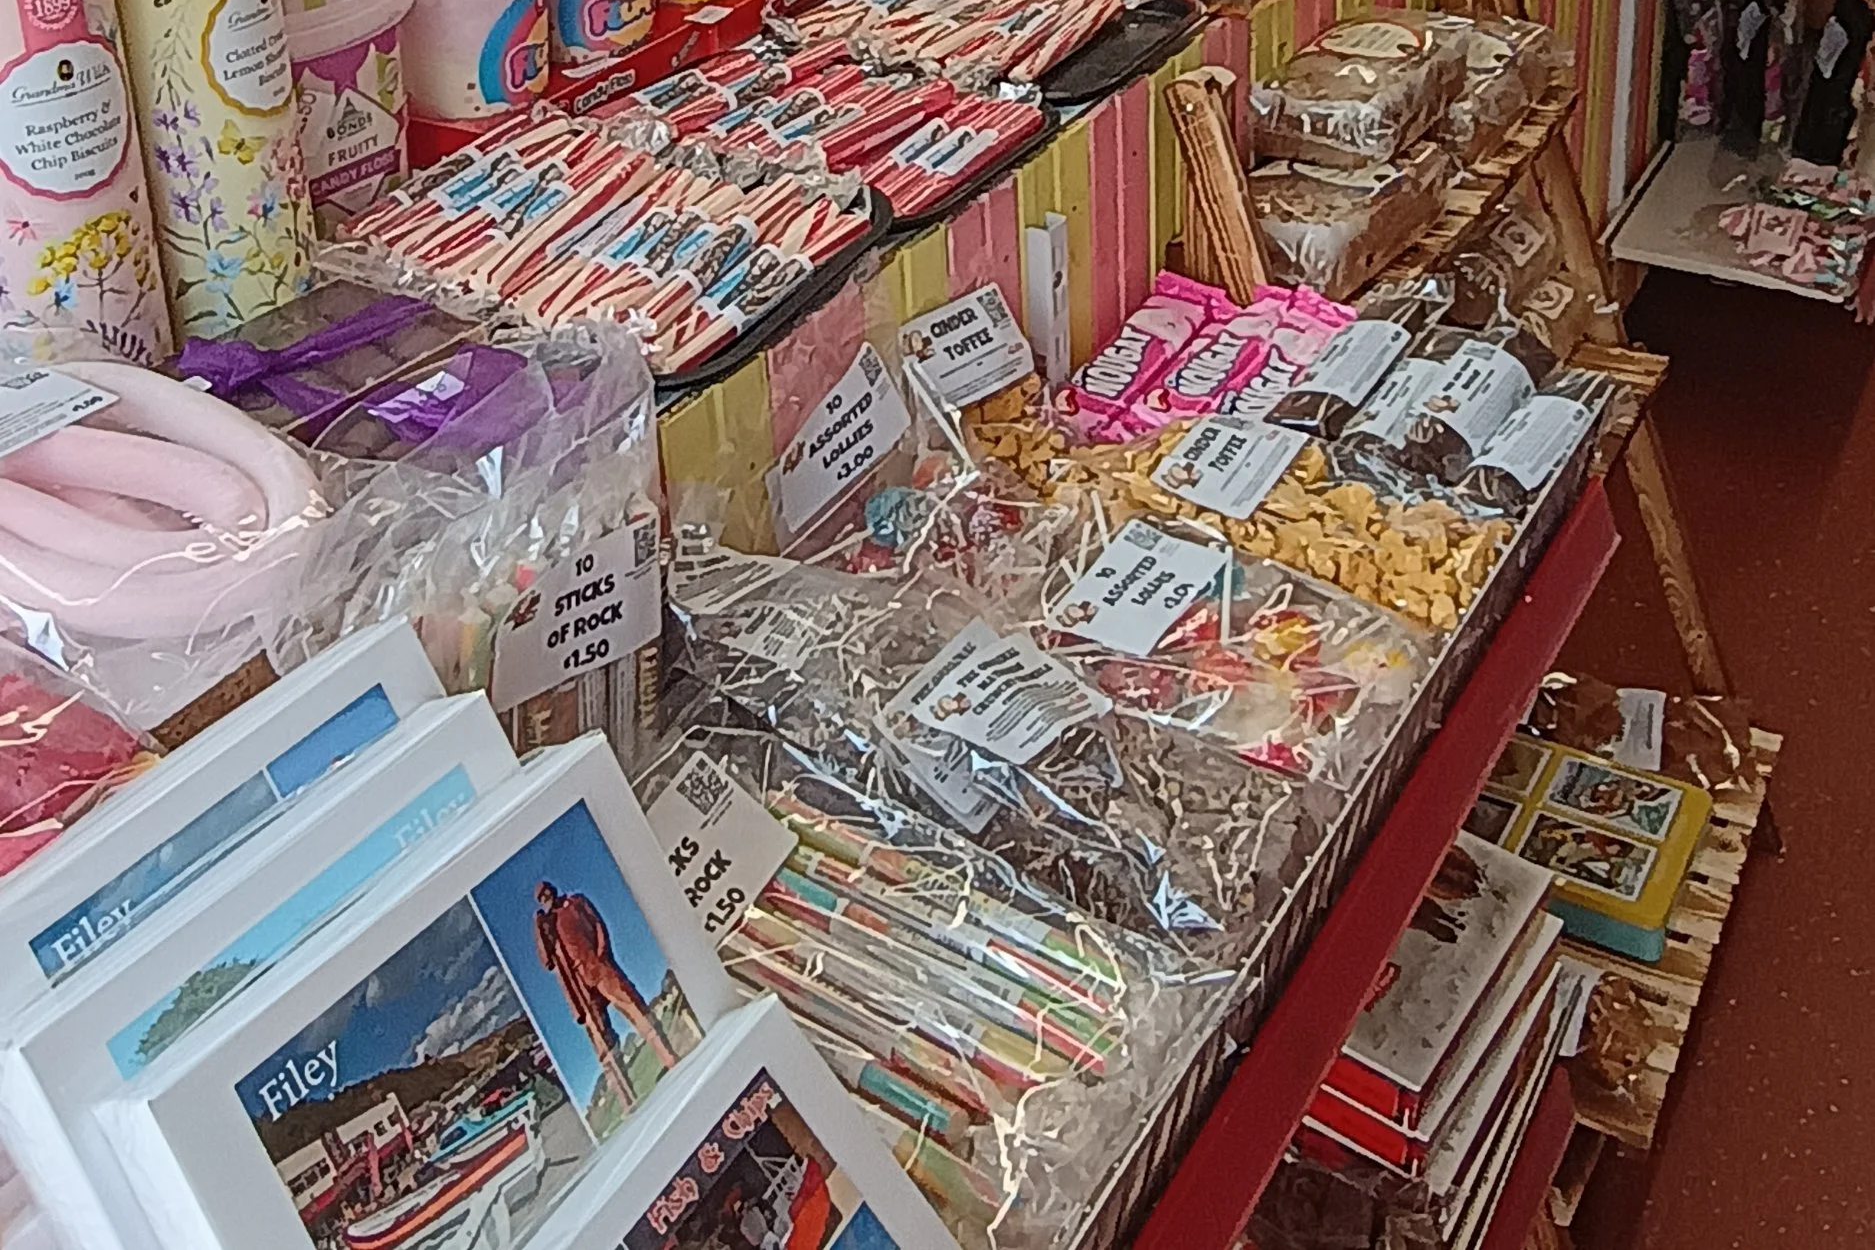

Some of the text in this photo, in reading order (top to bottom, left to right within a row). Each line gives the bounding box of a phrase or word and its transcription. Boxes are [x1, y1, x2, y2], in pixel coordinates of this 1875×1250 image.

[225, 36, 268, 64] Clotted
[223, 60, 265, 82] Lemon
[15, 115, 122, 156] White Chocolate
[25, 105, 99, 137] Raspberry
[326, 111, 373, 140] BONDS
[31, 134, 119, 172] Chip Biscuits
[328, 133, 379, 167] FRUITY
[311, 149, 396, 196] CANDY FLOSS
[930, 306, 978, 340] CINDER
[945, 326, 995, 361] TOFFEE
[1083, 326, 1153, 400] NOUGAT
[1172, 331, 1243, 399] NOUGAT
[825, 393, 844, 416] 10
[808, 392, 875, 461] ASSORTED
[821, 419, 875, 469] LOLLIES
[1209, 433, 1247, 473] TOFFEE
[574, 553, 595, 577] 10
[1101, 555, 1158, 606] ASSORTED
[553, 573, 616, 617] STICKS
[547, 600, 624, 649] OF ROCK
[683, 848, 732, 909] ROCK
[51, 898, 134, 967] Filey
[258, 1040, 340, 1121] Filey
